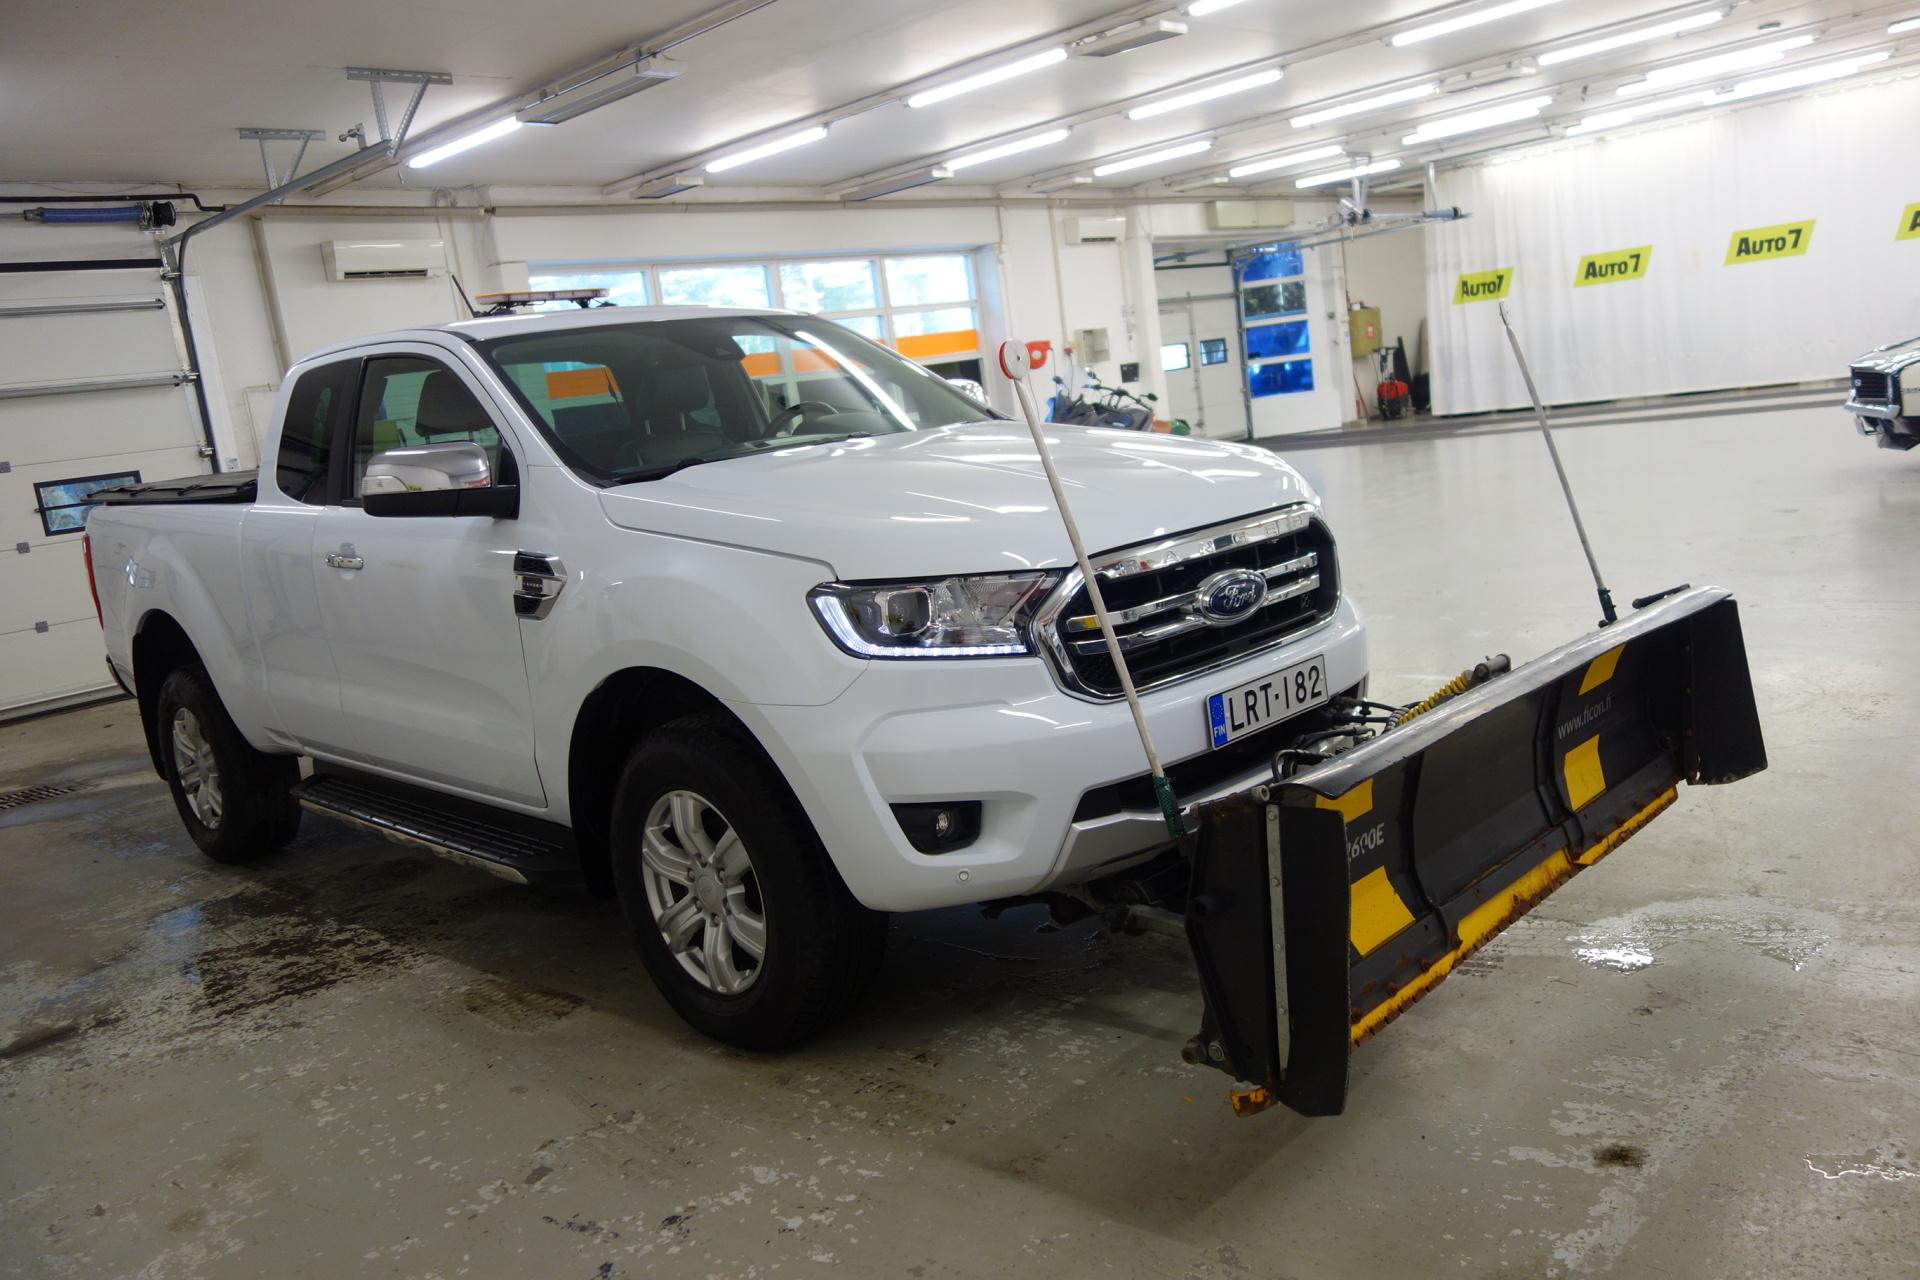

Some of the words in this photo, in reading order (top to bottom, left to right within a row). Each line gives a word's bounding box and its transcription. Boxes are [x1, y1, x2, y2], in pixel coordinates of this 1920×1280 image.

[1217, 583, 1257, 608] Ford
[1228, 665, 1322, 732] LRT-182
[1558, 691, 1613, 739] www.ficon.fi
[1213, 724, 1226, 738] FIN
